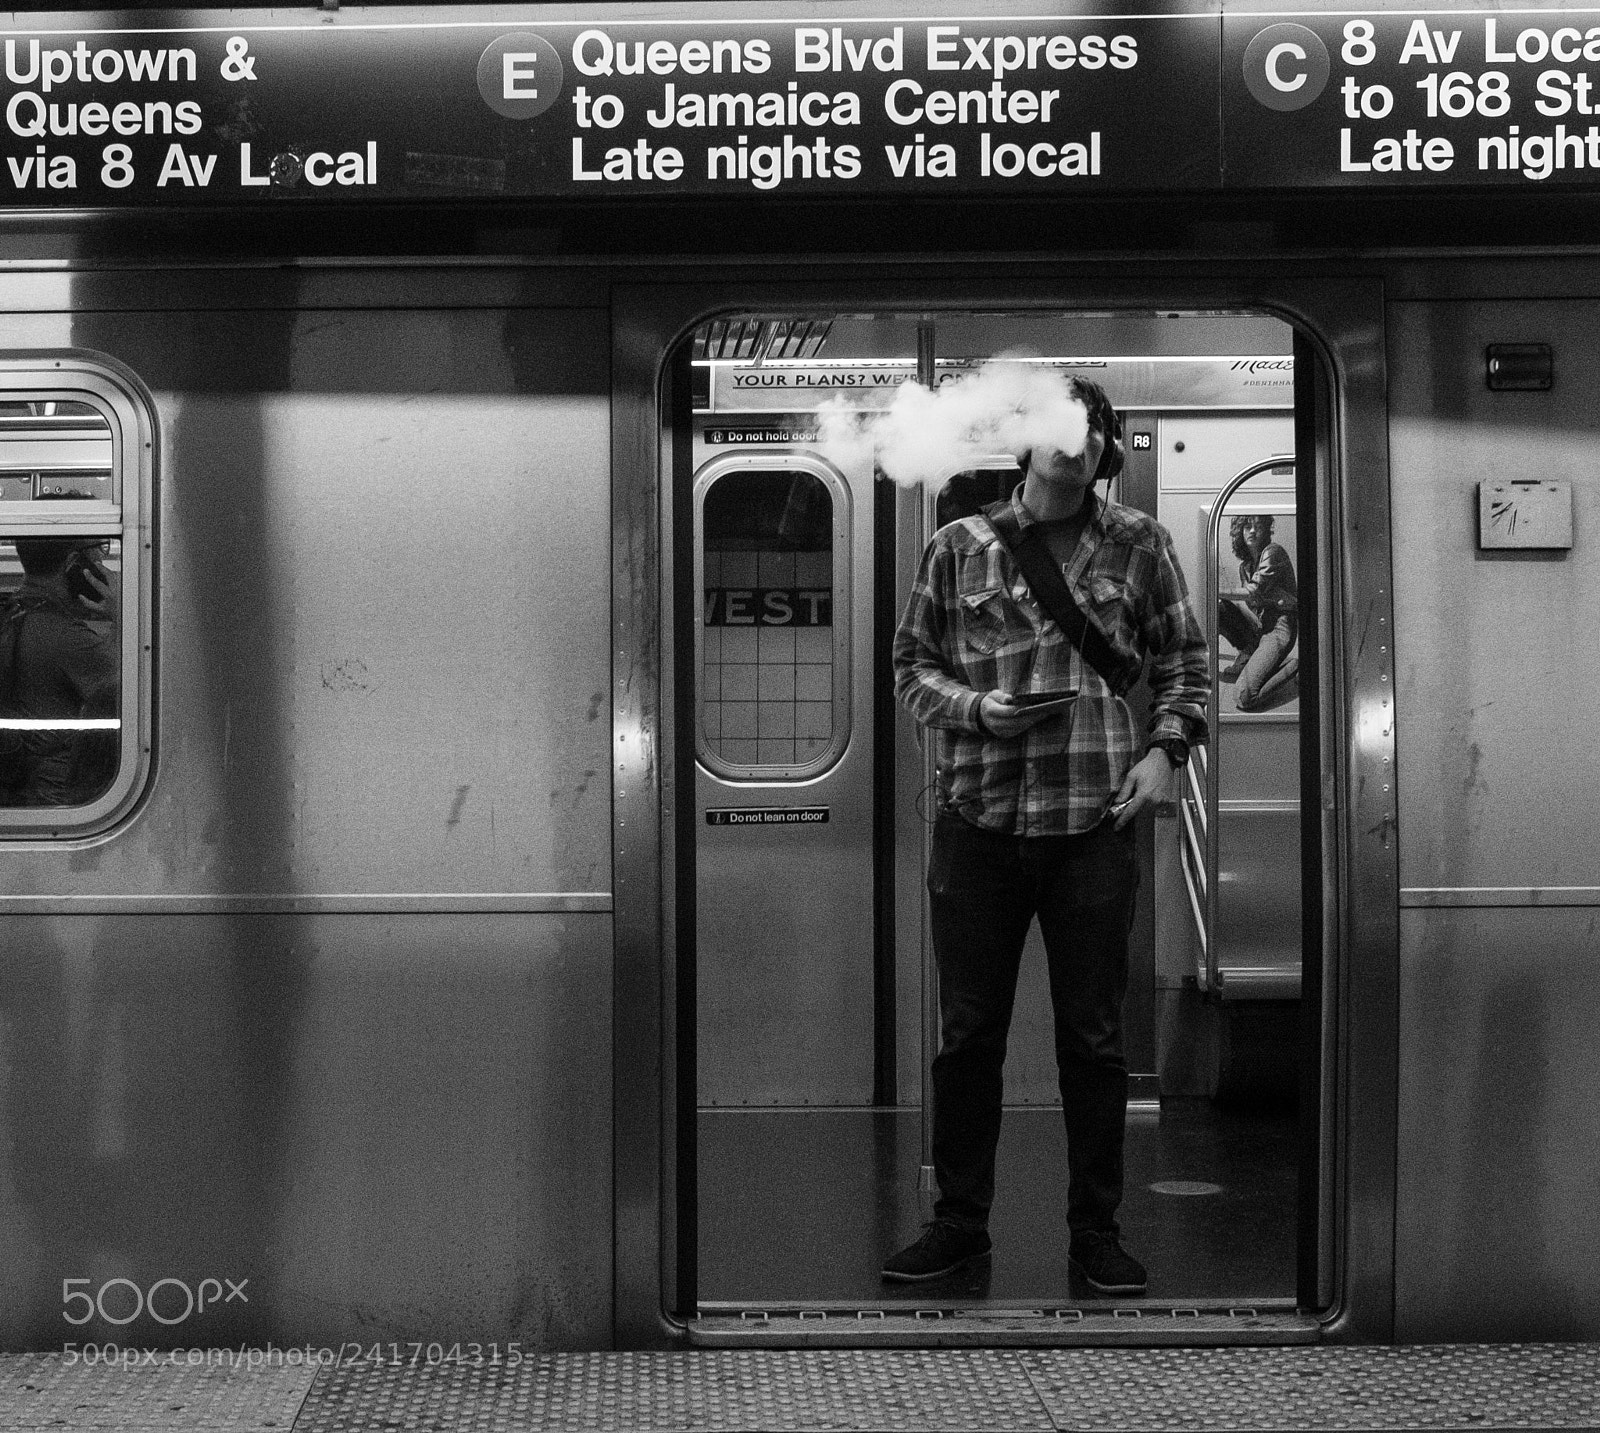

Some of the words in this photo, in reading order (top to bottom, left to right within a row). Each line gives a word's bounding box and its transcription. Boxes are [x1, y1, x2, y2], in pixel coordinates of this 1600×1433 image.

[5, 39, 197, 92] Uptown
[221, 36, 257, 81] &
[572, 30, 771, 76] Queens
[795, 28, 903, 72] Blvd
[927, 26, 1138, 79] Express
[1342, 18, 1376, 65] 8
[1399, 20, 1462, 64] Av
[503, 53, 537, 99] E
[1265, 43, 1307, 92] C
[7, 91, 202, 137] Queens
[573, 87, 624, 128] to
[647, 82, 860, 128] Jamaica
[885, 79, 1059, 125] Center
[1341, 77, 1393, 119] to
[1417, 71, 1511, 117] 168
[7, 146, 76, 188] via
[101, 144, 134, 188] 8
[157, 144, 217, 186] Av
[241, 141, 376, 186] Lcal
[573, 138, 684, 180] Late
[708, 135, 861, 189] nights
[885, 134, 956, 177] via
[981, 132, 1100, 177] local
[1341, 128, 1454, 171] Late
[733, 374, 788, 386] YOUR
[795, 374, 866, 386] PLANS?
[728, 431, 743, 441] Do
[746, 431, 763, 441] not
[766, 430, 789, 441] hold
[1133, 435, 1150, 447] R8
[730, 813, 744, 822] Do
[745, 813, 762, 822] not
[764, 812, 785, 821] lean
[786, 812, 799, 821] on
[801, 811, 824, 821] door
